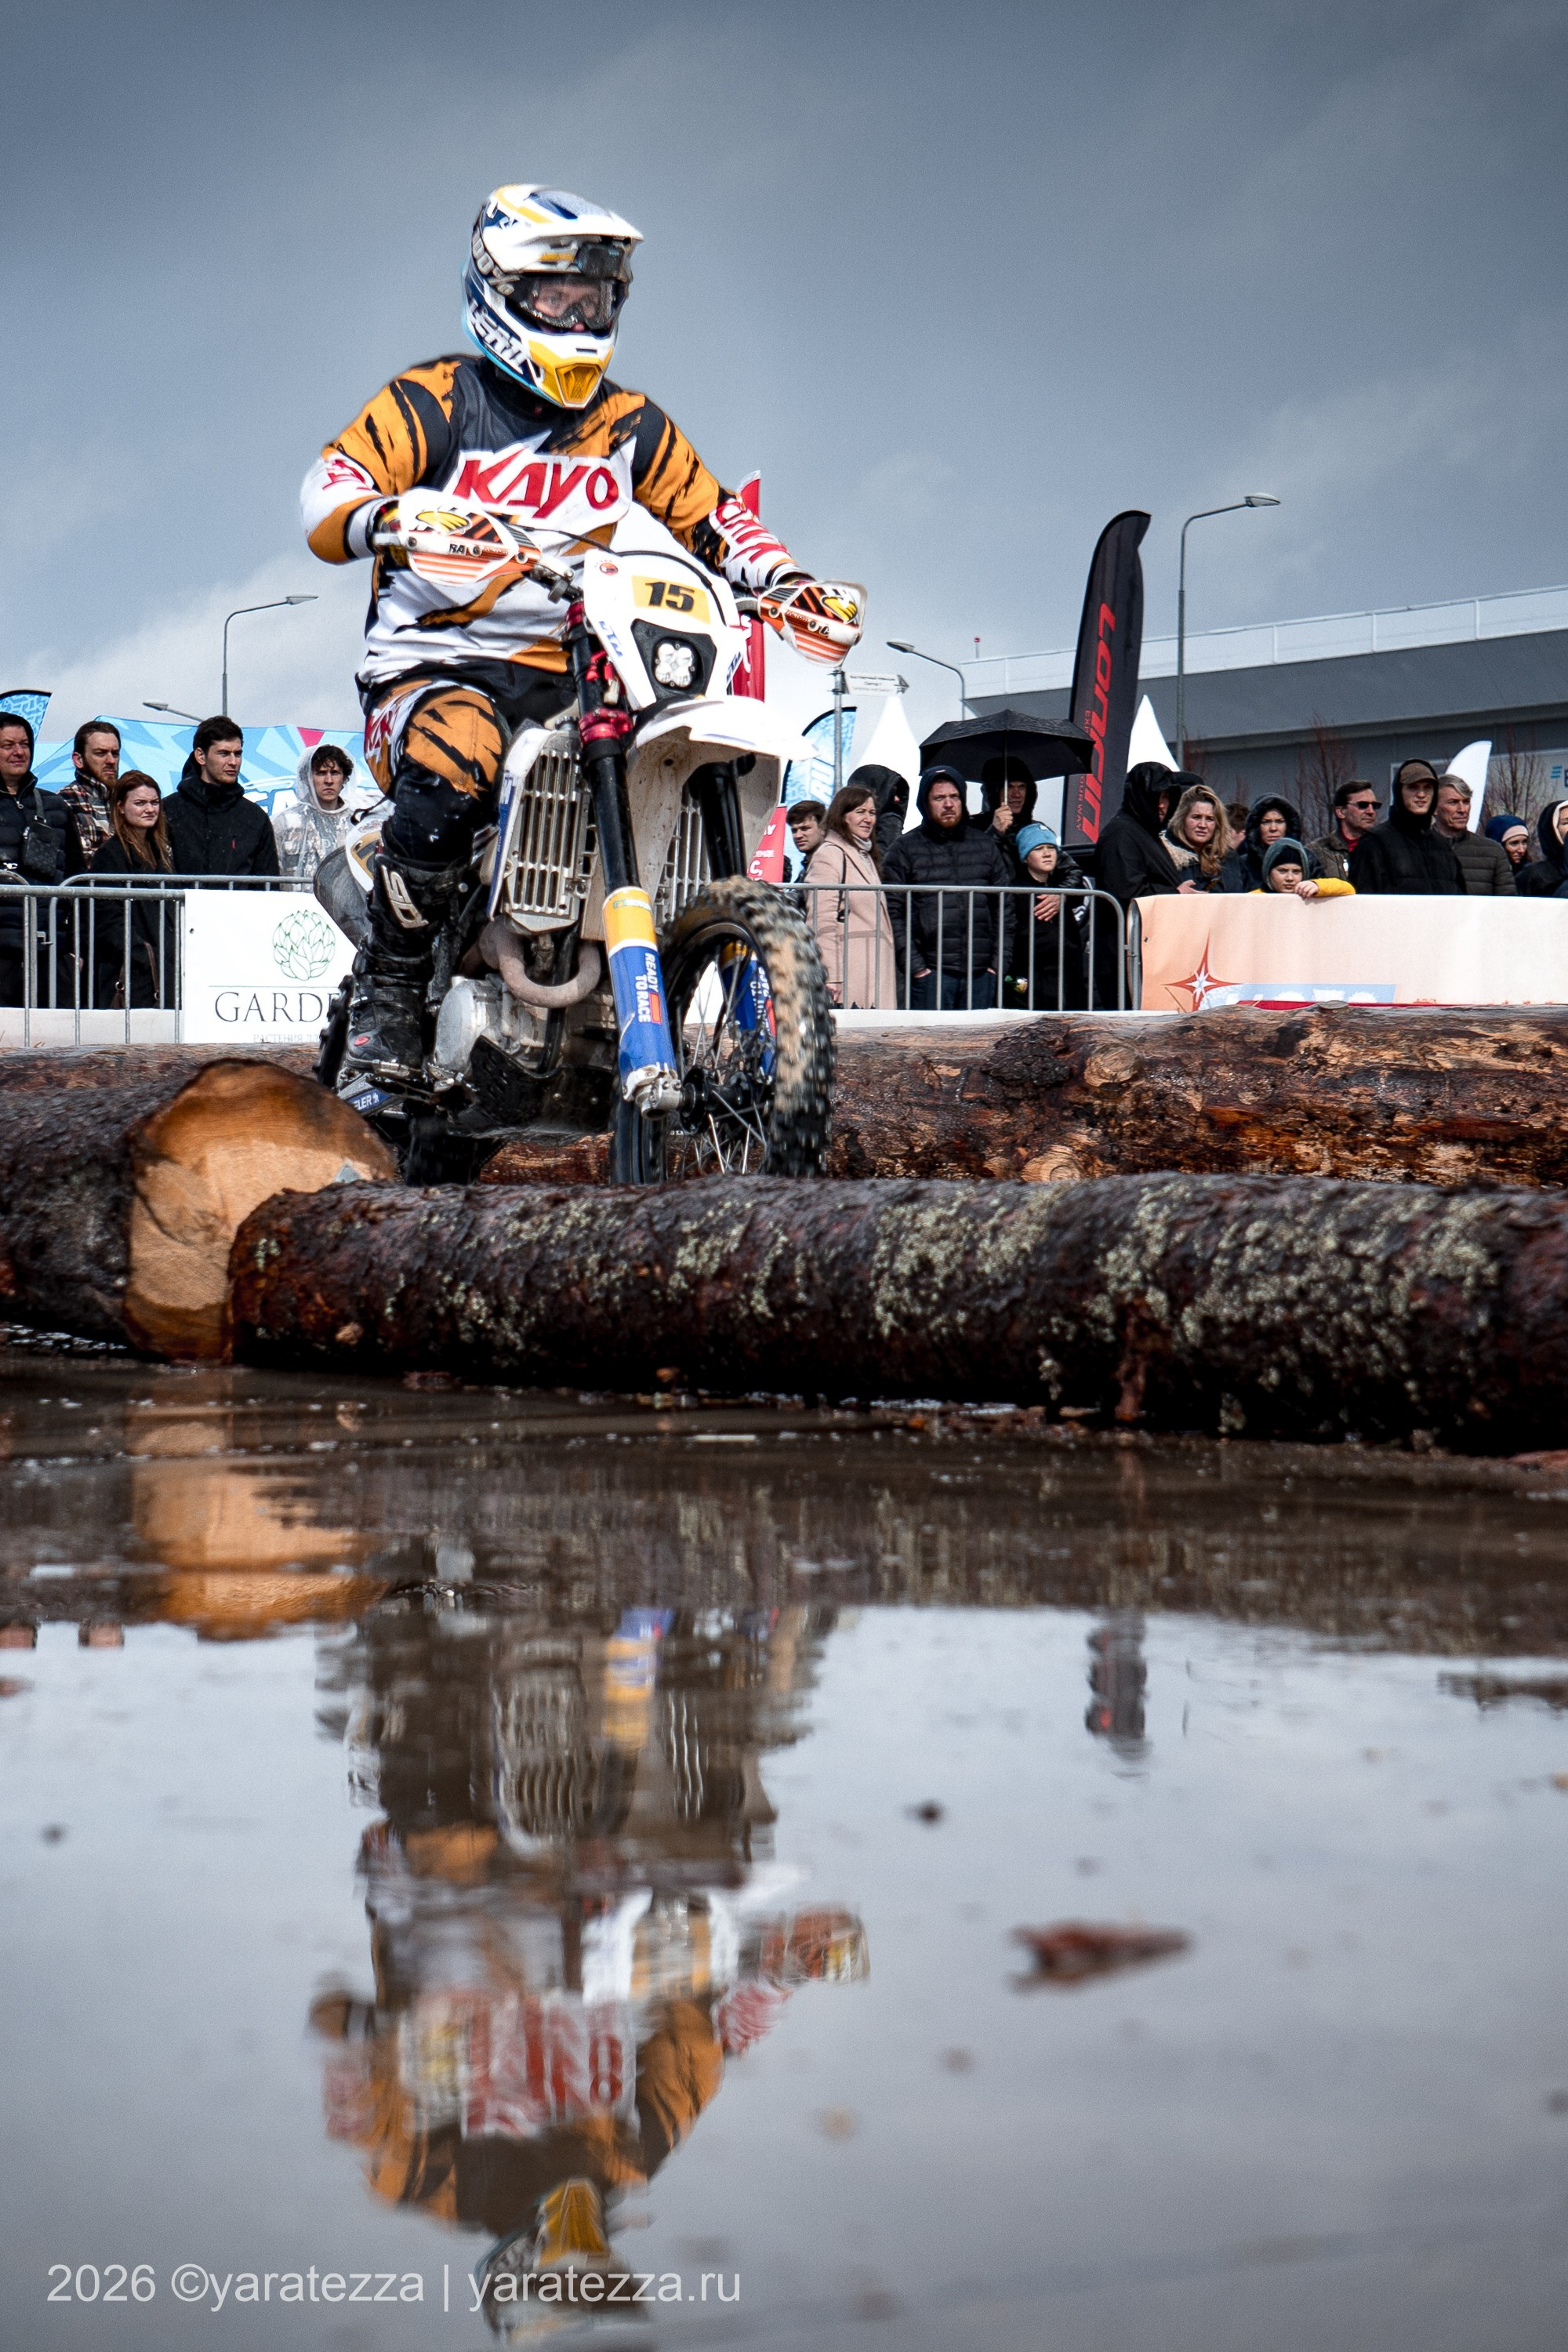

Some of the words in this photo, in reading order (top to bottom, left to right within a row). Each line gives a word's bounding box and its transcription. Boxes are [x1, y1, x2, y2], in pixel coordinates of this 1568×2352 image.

[452, 446, 619, 518] KAYO
[645, 581, 696, 613] 15
[645, 953, 659, 993] READY
